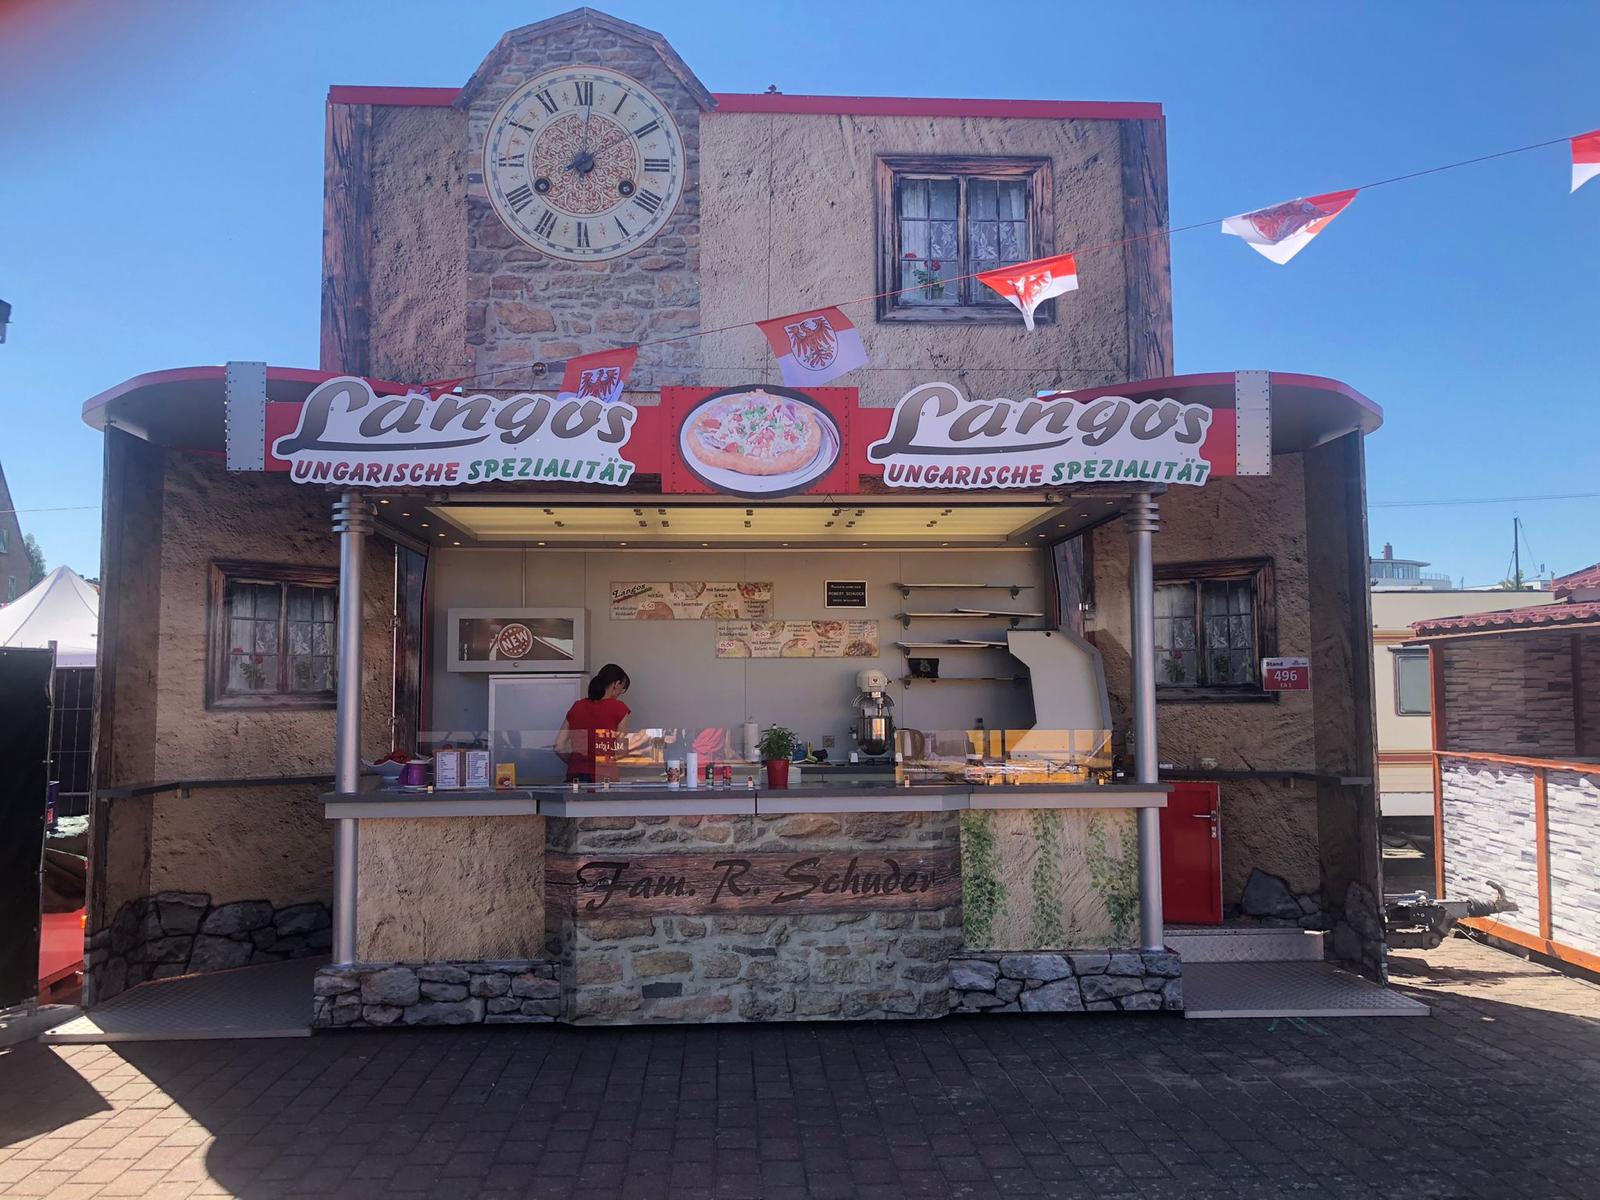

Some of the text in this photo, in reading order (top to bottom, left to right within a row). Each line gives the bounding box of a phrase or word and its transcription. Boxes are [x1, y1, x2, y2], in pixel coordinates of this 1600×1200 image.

[574, 81, 593, 106] XII
[643, 158, 670, 172] III
[275, 380, 633, 455] Langos
[870, 386, 1210, 460] Langos
[294, 457, 634, 483] UNGARISCHE SPEZIALITÄT
[888, 459, 1210, 484] UNGARISCHE SPEZIALITÄT
[501, 630, 528, 651] NEW
[1273, 670, 1298, 682] 496
[575, 861, 696, 912] Fam.
[710, 858, 760, 904] R.
